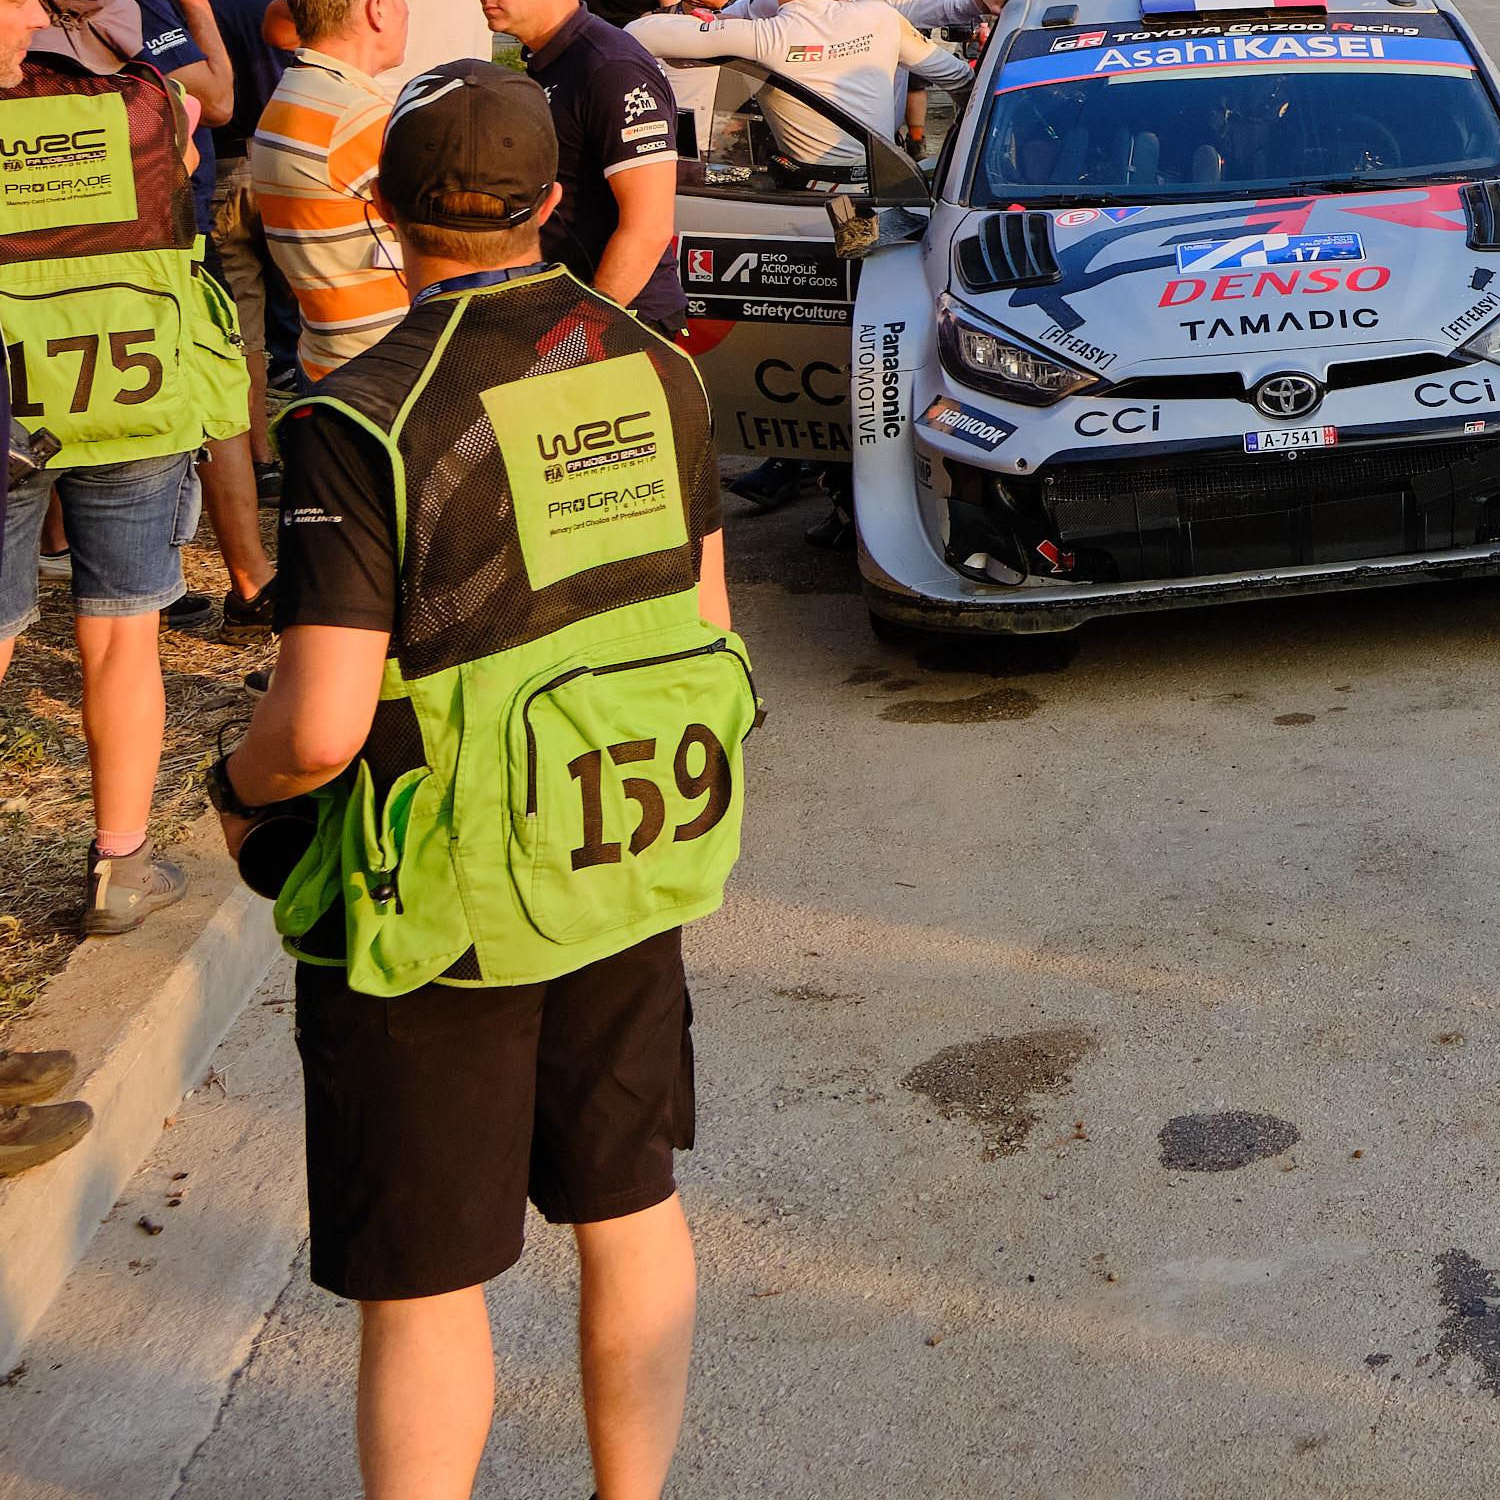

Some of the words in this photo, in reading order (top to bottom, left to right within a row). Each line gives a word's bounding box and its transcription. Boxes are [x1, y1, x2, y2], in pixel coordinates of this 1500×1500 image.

[146, 28, 186, 50] WRC
[787, 51, 823, 62] GR
[827, 33, 874, 49] TOYOTA
[828, 40, 871, 55] GAZOO
[1054, 35, 1105, 52] GR
[1112, 25, 1222, 43] TOYOTA
[1228, 22, 1326, 36] GAZOO
[1331, 21, 1420, 37] Racing
[828, 46, 871, 60] Racing
[1094, 36, 1386, 72] AsahiKASEI
[0, 128, 106, 156] WRC
[636, 141, 667, 153] sparco
[761, 253, 788, 262] EKO
[1291, 246, 1322, 262] 17
[761, 263, 817, 275] ACROPOLIS
[761, 274, 791, 286] RALLY
[792, 276, 807, 286] OF
[808, 276, 838, 288] GODS
[1157, 266, 1391, 308] DENSO
[687, 300, 707, 313] SC
[743, 303, 848, 321] SafetyCulture
[1179, 308, 1379, 342] TAMADIC
[8, 329, 164, 418] 175
[754, 358, 851, 407] CC
[858, 323, 877, 446] AUTOMOTIVE
[882, 321, 906, 439] Panasonic
[537, 411, 655, 461] WRC
[1263, 430, 1319, 448] A-7541
[1324, 426, 1334, 435] 11
[1324, 435, 1335, 445] 25
[544, 466, 564, 483] FIA
[582, 453, 619, 469] WORLD
[620, 444, 657, 461] RALLY
[568, 455, 657, 480] CHAMPIONSHIP
[294, 508, 324, 516] JAPAN
[604, 494, 666, 513] DIGITAL
[295, 515, 343, 523] AIRLINES
[586, 515, 610, 528] Choice
[620, 503, 666, 521] Professionals
[566, 724, 732, 872] 159
